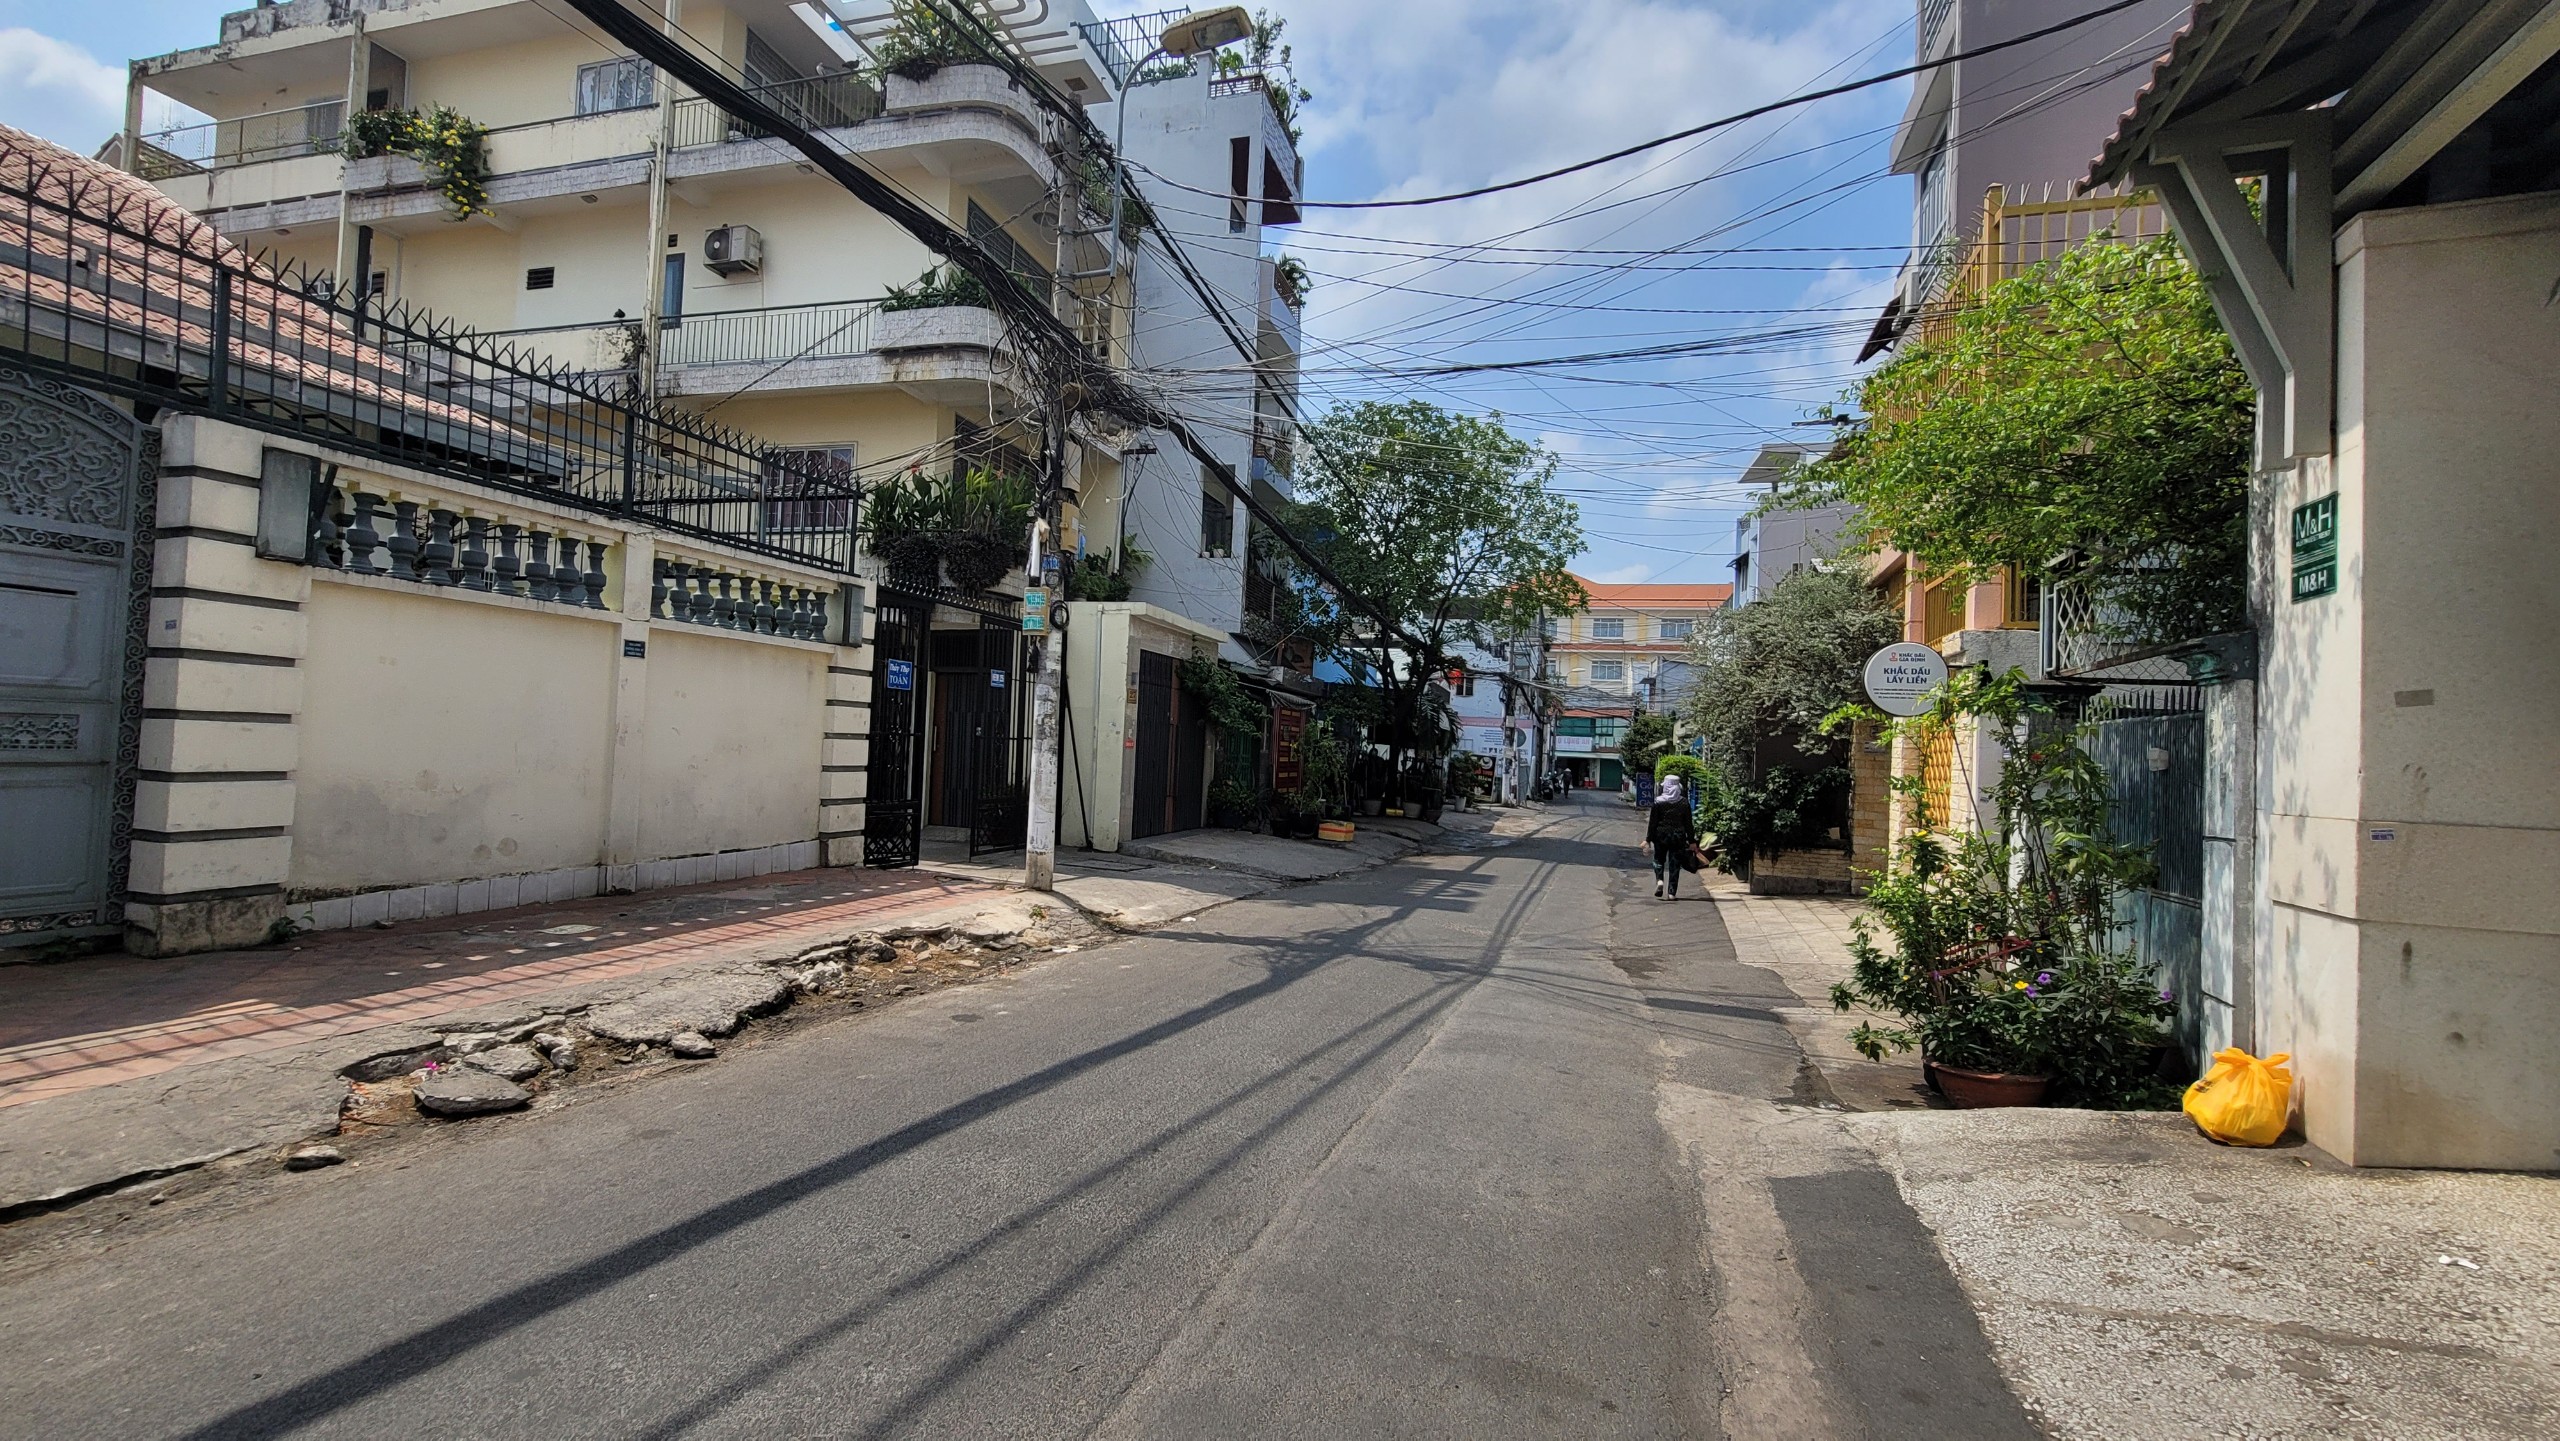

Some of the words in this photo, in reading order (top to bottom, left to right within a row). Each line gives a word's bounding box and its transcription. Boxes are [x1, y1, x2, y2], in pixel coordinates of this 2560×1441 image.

[2296, 500, 2332, 540] M&H
[2299, 570, 2327, 594] M&H
[1883, 665, 1909, 675] KHẮC
[1911, 666, 1931, 675] DẤU
[890, 674, 908, 685] TOÁN
[1887, 674, 1904, 683] LẤY
